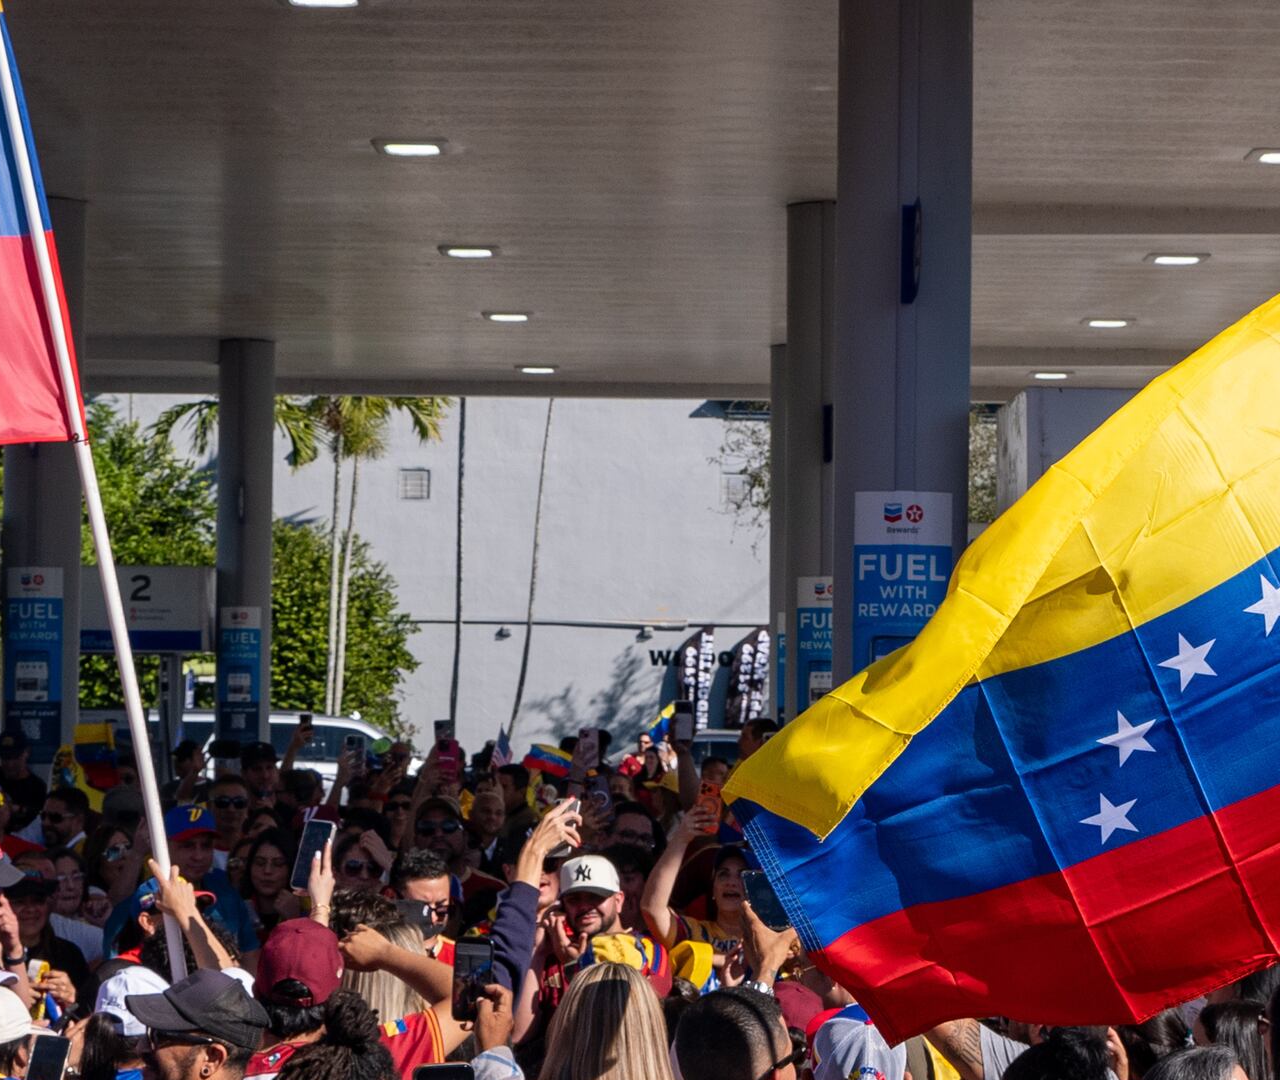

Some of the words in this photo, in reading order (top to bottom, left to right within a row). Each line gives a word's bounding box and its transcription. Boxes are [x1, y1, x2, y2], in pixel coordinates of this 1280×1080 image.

[858, 553, 946, 582] FUEL
[130, 574, 151, 601] 2
[879, 585, 927, 599] WITH
[9, 603, 59, 620] FUEL
[858, 603, 937, 618] REWARD
[800, 613, 833, 628] FU
[812, 630, 832, 639] WIT
[800, 641, 833, 650] REWA
[696, 673, 710, 729] INDOW
